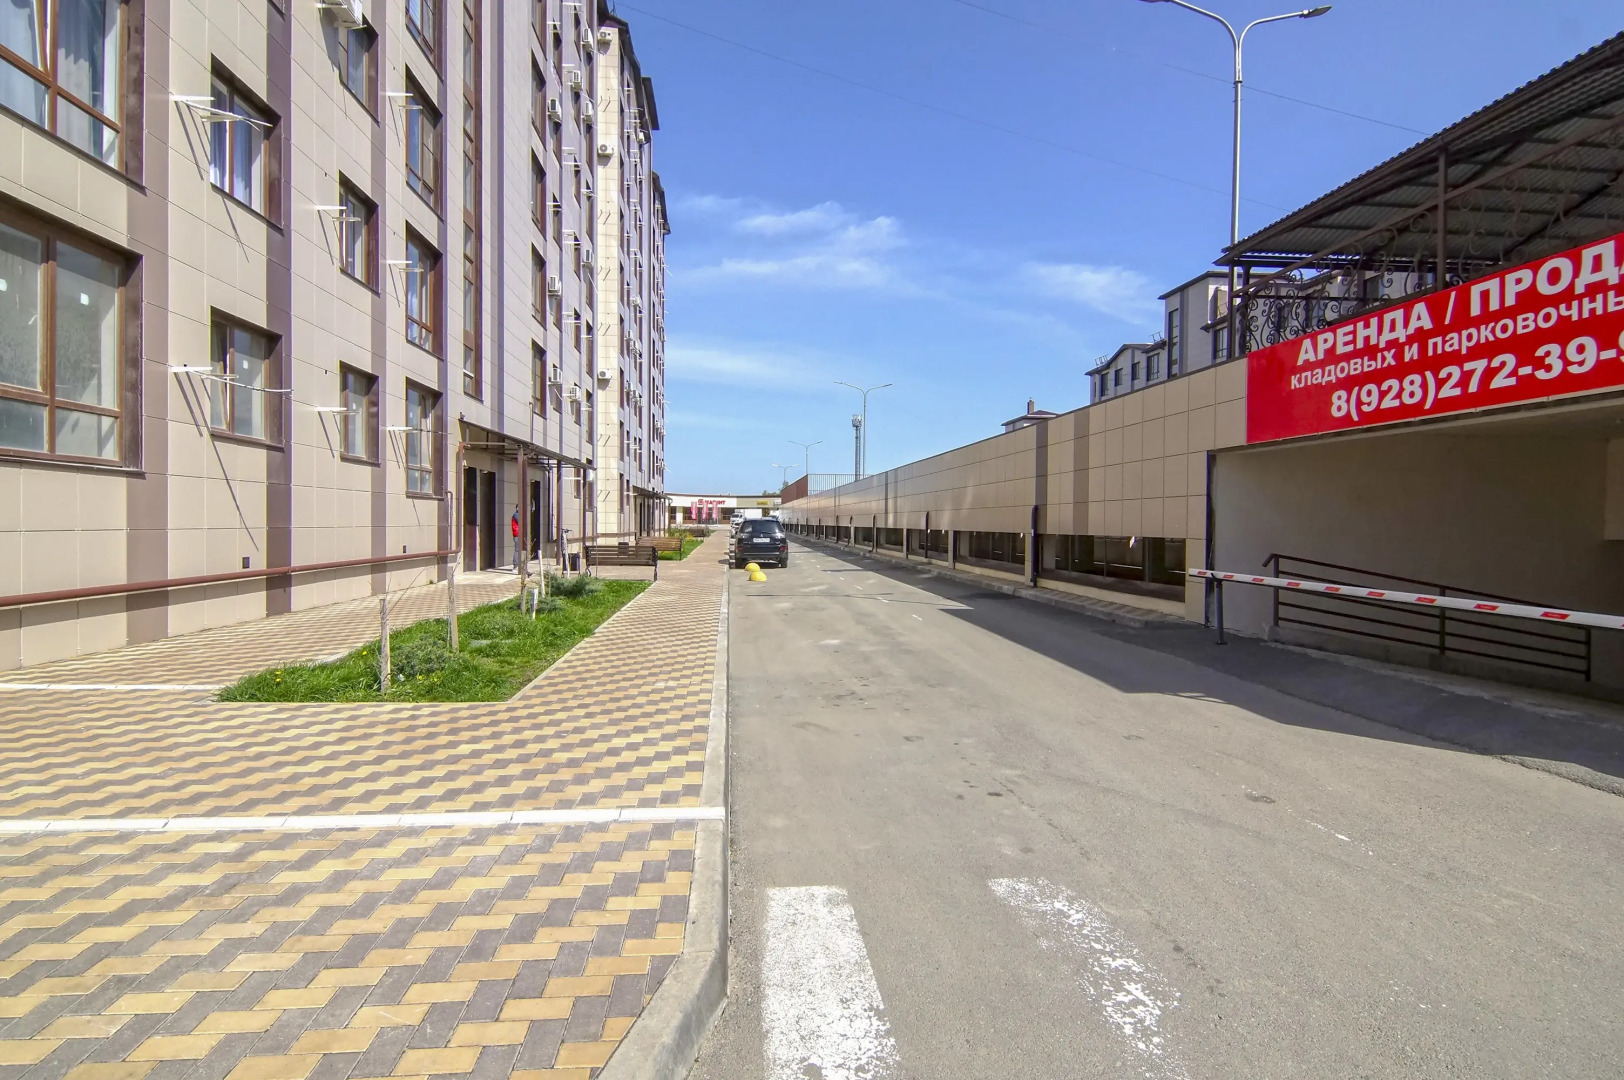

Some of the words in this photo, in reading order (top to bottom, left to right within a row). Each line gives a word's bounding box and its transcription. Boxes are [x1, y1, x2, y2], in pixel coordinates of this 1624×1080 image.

[1296, 301, 1433, 366] АРЕНДА
[1470, 239, 1624, 317] ПРОД
[1290, 348, 1397, 390] кладовых
[1330, 331, 1624, 421] 8(928)272-39-
